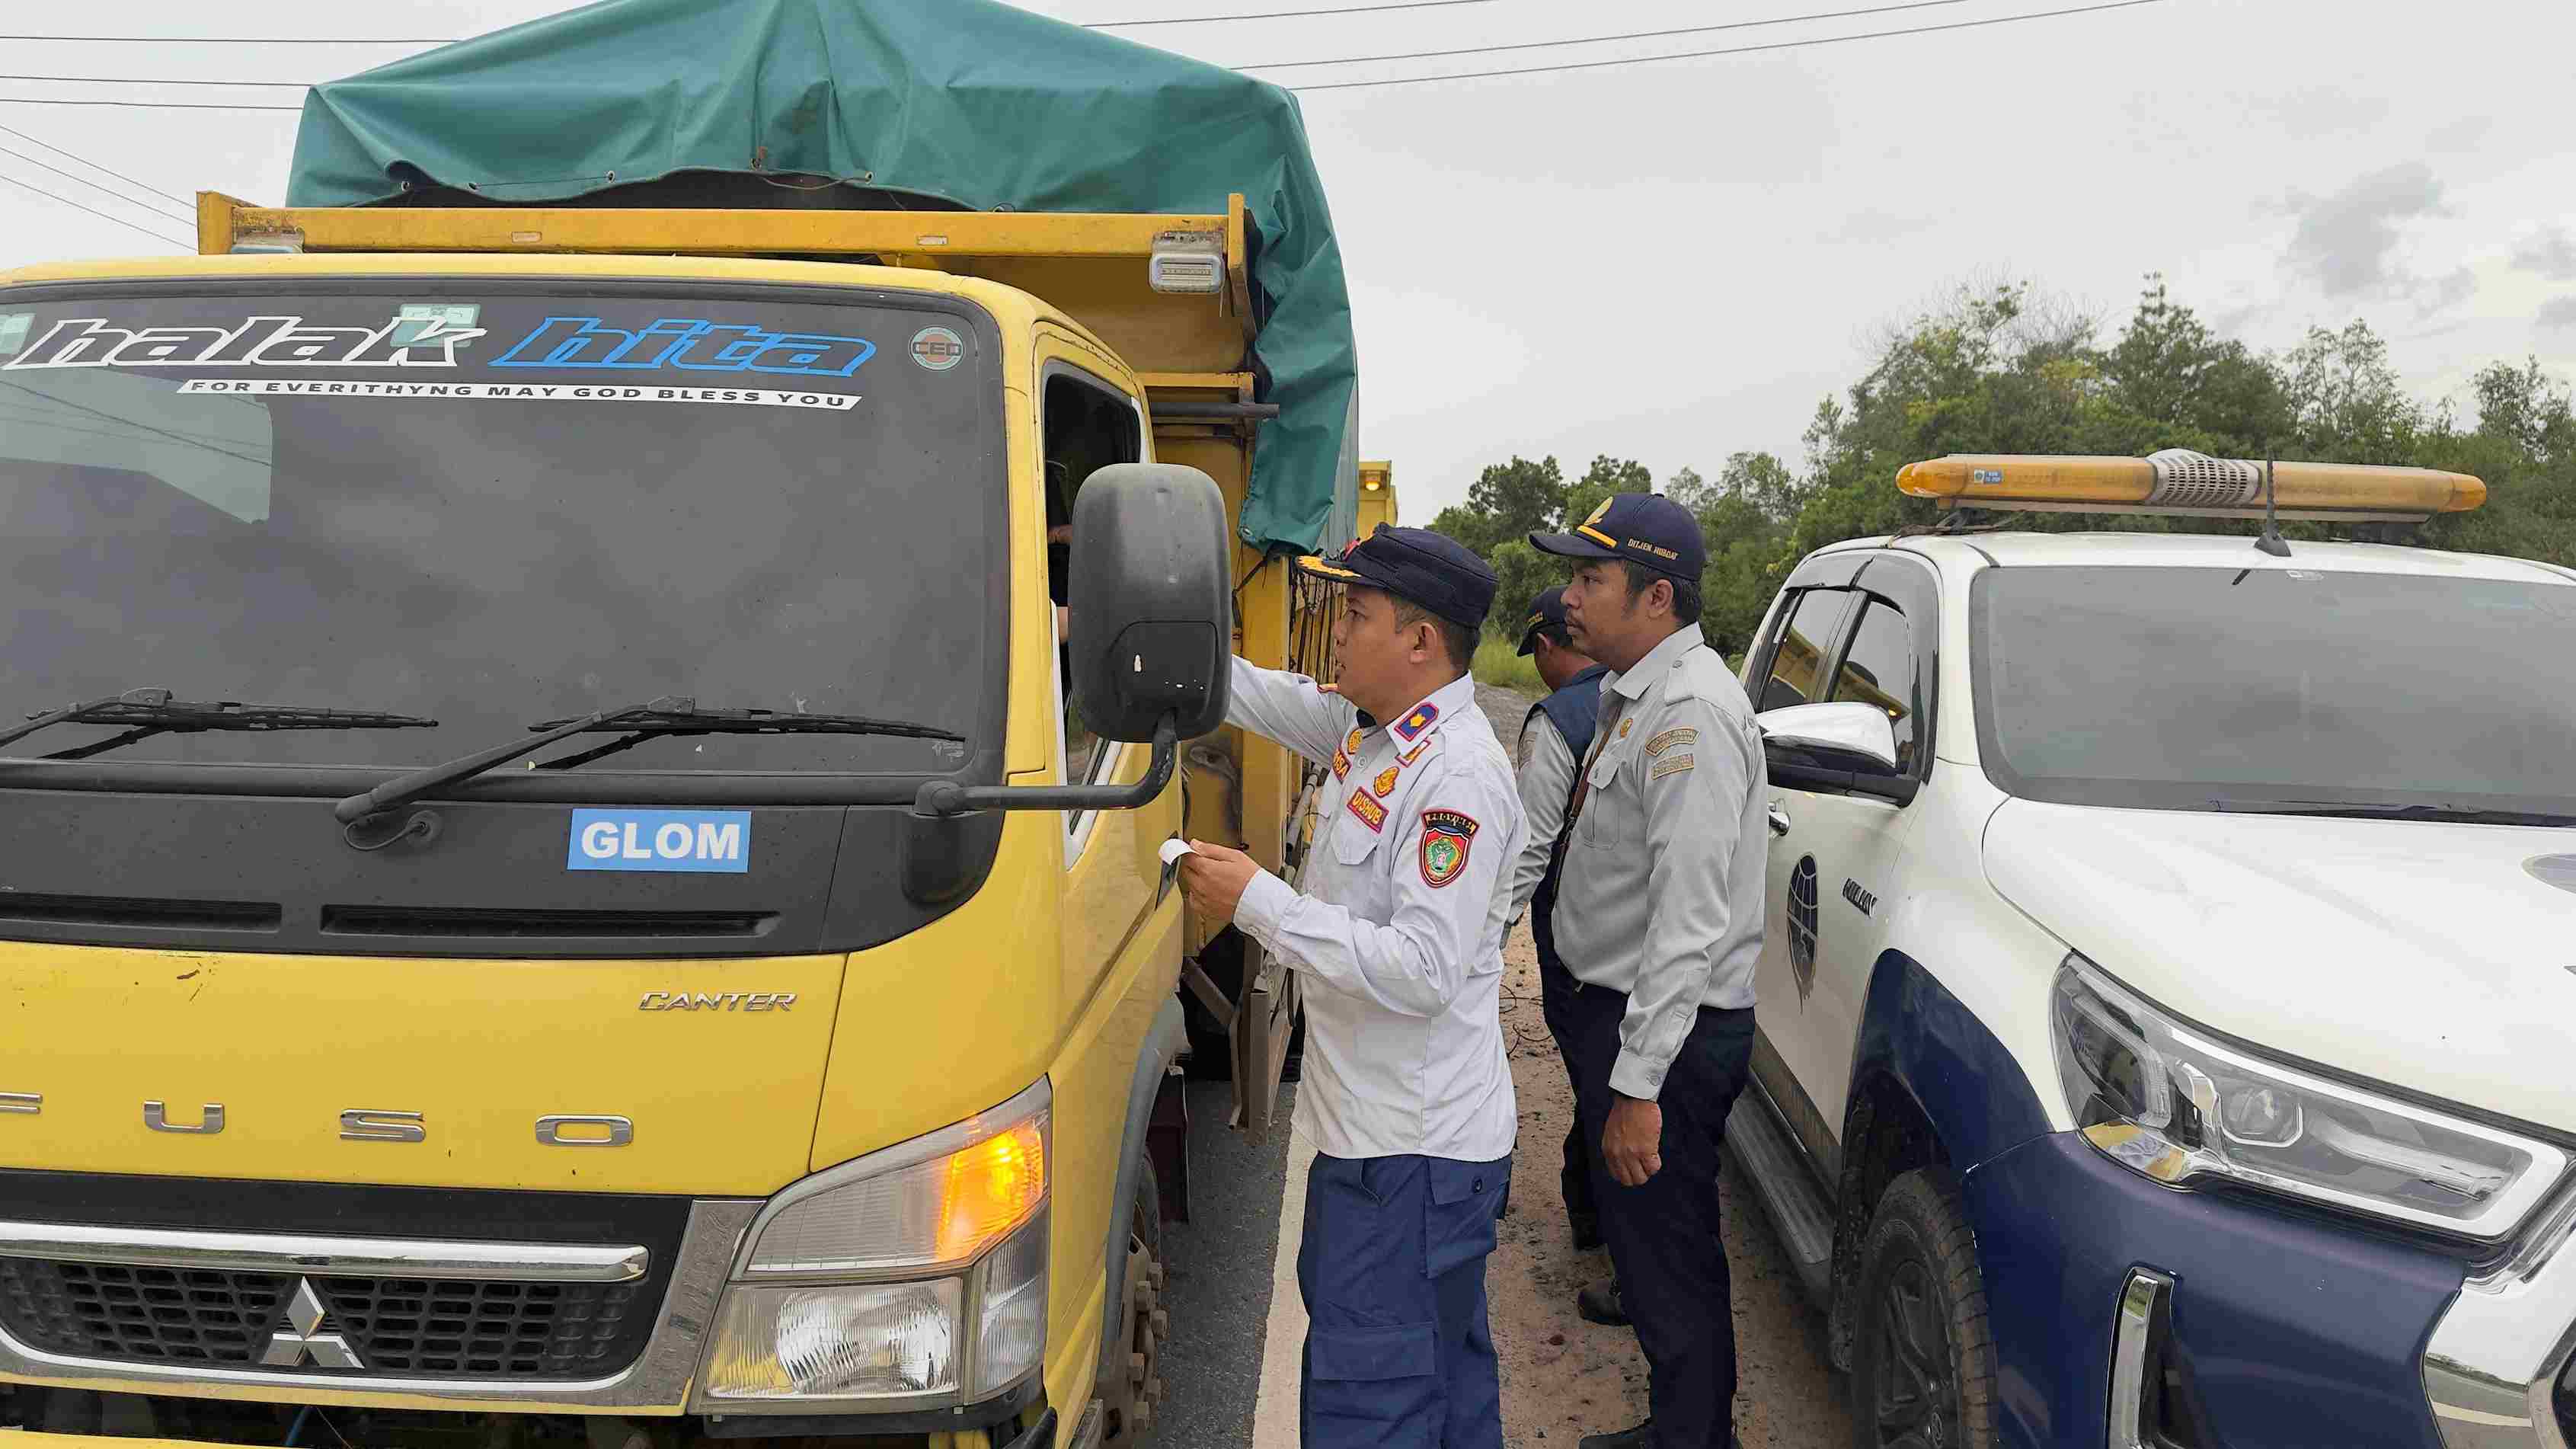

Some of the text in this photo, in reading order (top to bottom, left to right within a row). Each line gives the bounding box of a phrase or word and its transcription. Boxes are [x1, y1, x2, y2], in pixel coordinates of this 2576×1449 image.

[191, 382, 845, 408] FOR EVERITHYNG MAY GOD BLESS YOU
[1352, 792, 1382, 824] DISHUB
[581, 821, 741, 859] GLOM
[638, 992, 797, 1012] CANTER
